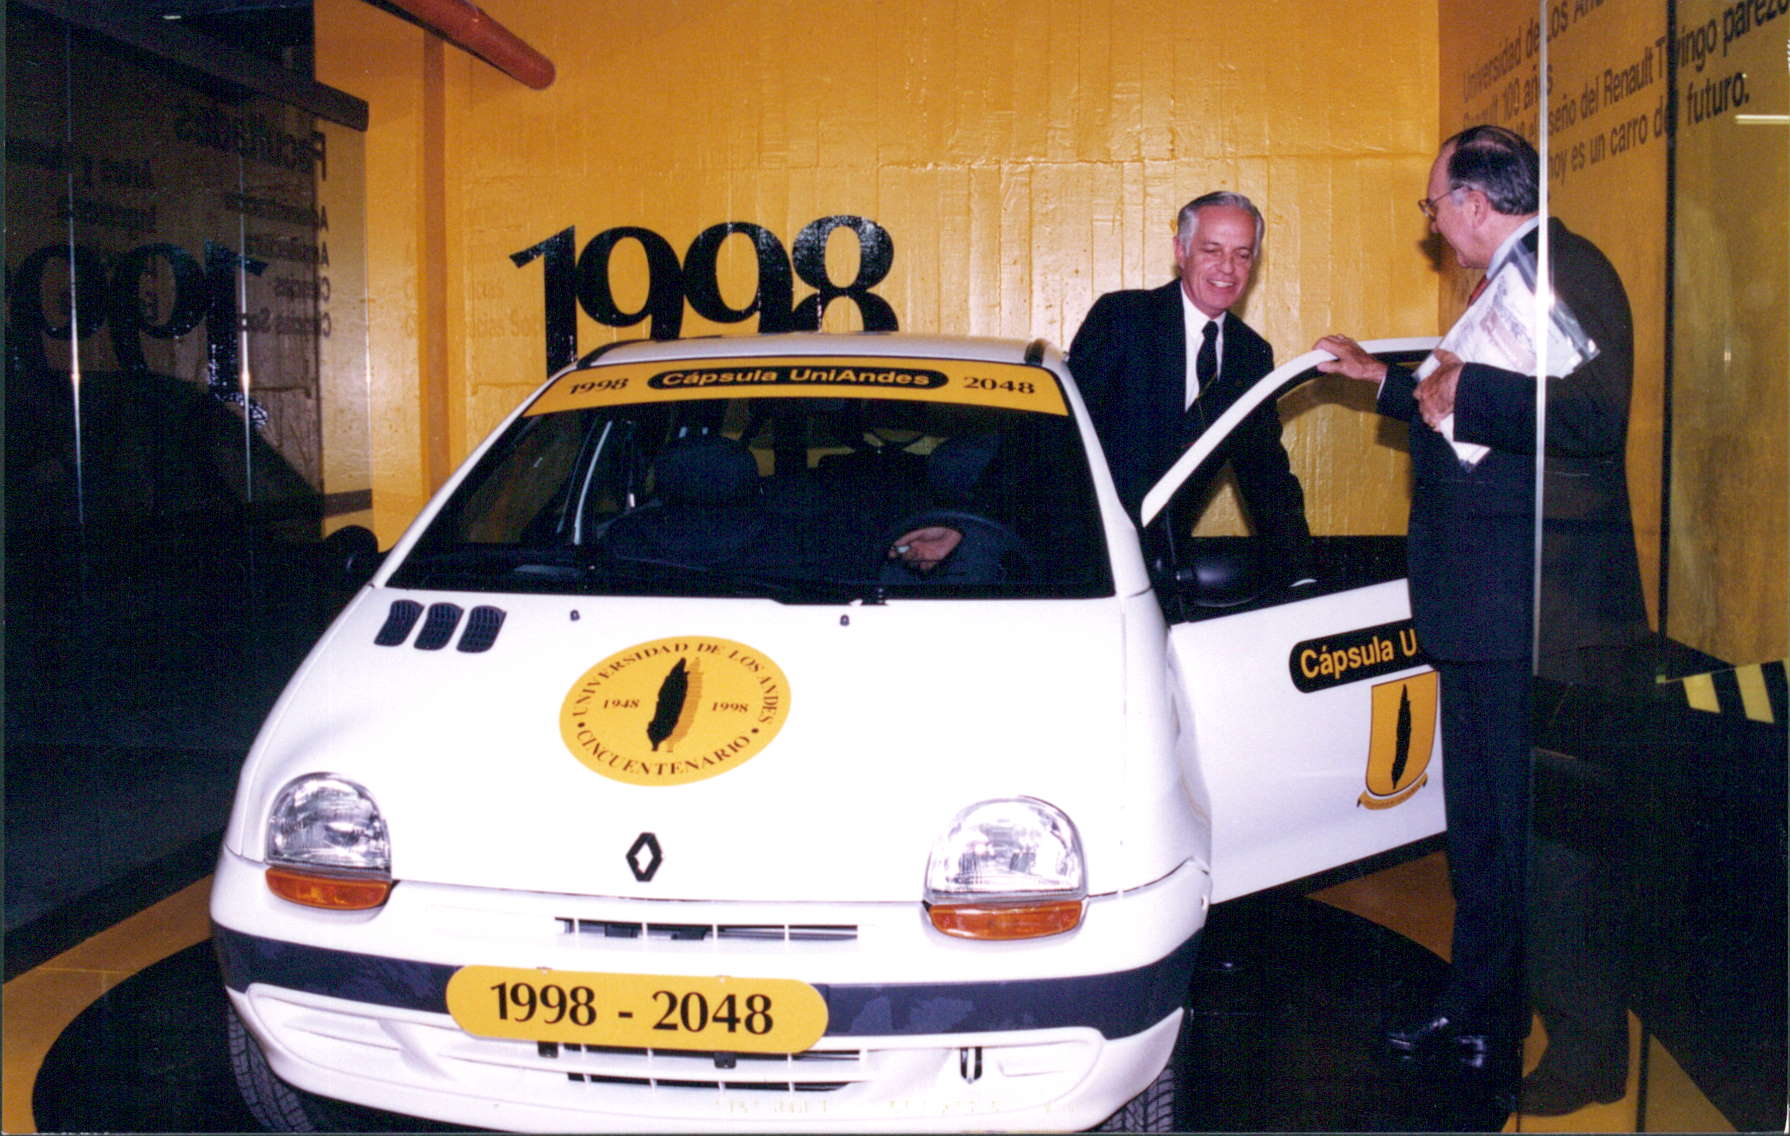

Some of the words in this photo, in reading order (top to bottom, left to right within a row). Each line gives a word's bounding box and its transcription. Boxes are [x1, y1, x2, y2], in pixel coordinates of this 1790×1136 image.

[1463, 24, 1521, 104] Universidad
[1526, 17, 1540, 58] de
[1546, 1, 1568, 42] os
[1580, 76, 1600, 120] del
[1604, 68, 1654, 107] Renault
[1655, 18, 1718, 79] Tingo
[1571, 141, 1586, 172] es
[1590, 132, 1606, 165] un
[1610, 113, 1649, 156] carro
[1687, 72, 1750, 126] futuro.
[509, 214, 900, 384] 1998
[570, 377, 630, 395] 1998
[662, 369, 778, 387] Cápsula
[789, 368, 931, 386] UniAndes
[963, 376, 1036, 395] 2048
[1300, 635, 1395, 680] Cápsula
[1400, 628, 1418, 657] U
[572, 643, 688, 717] UNIVERSIDAD
[697, 642, 724, 656] DE
[728, 649, 763, 674] LOS
[757, 674, 779, 725] ANDES
[603, 699, 640, 709] 1948
[711, 701, 749, 713] 1998
[576, 729, 752, 776] CINCUENTENARIO
[490, 982, 597, 1026] 1998
[652, 990, 774, 1036] 2048
